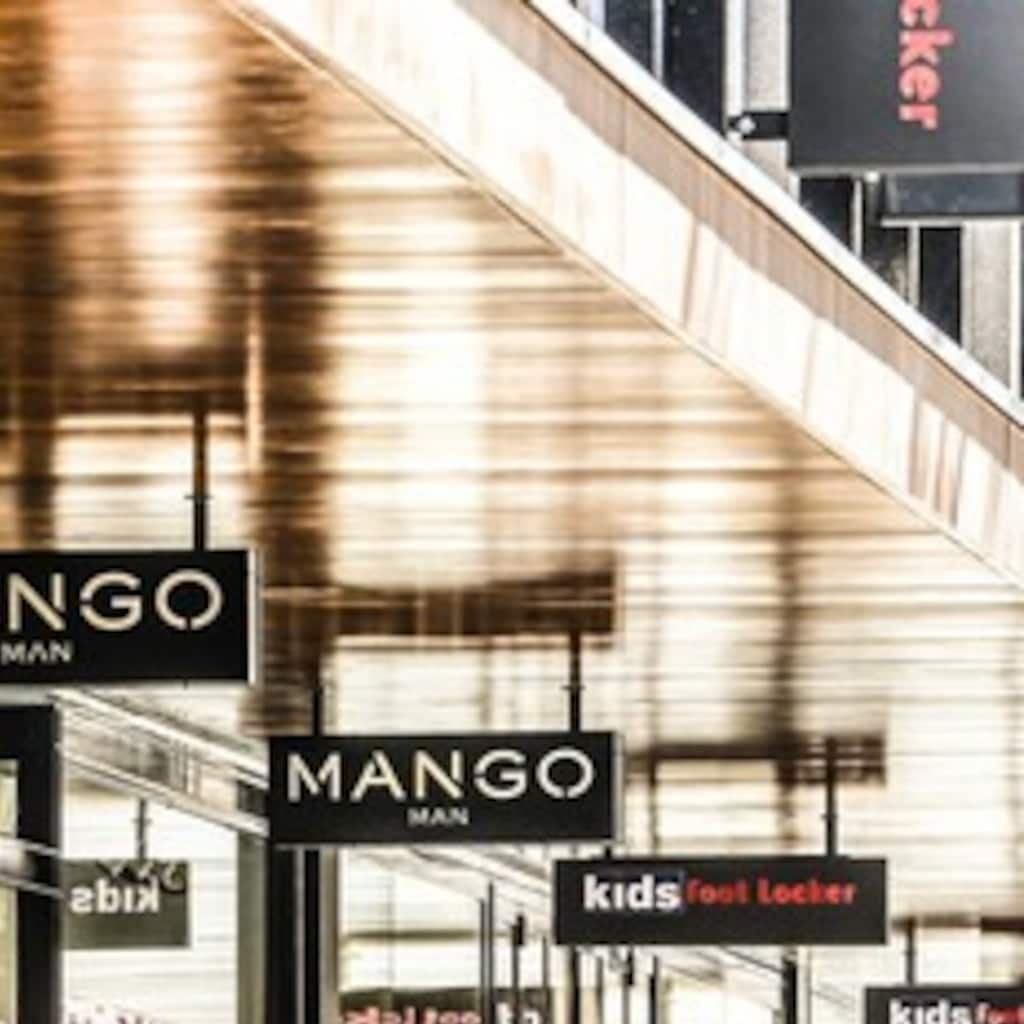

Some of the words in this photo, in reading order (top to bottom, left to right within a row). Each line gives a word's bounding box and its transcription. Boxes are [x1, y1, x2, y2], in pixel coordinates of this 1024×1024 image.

[0, 641, 73, 665] MAN
[287, 748, 594, 802] MANGO
[406, 807, 470, 827] MAN
[583, 874, 682, 910] kids
